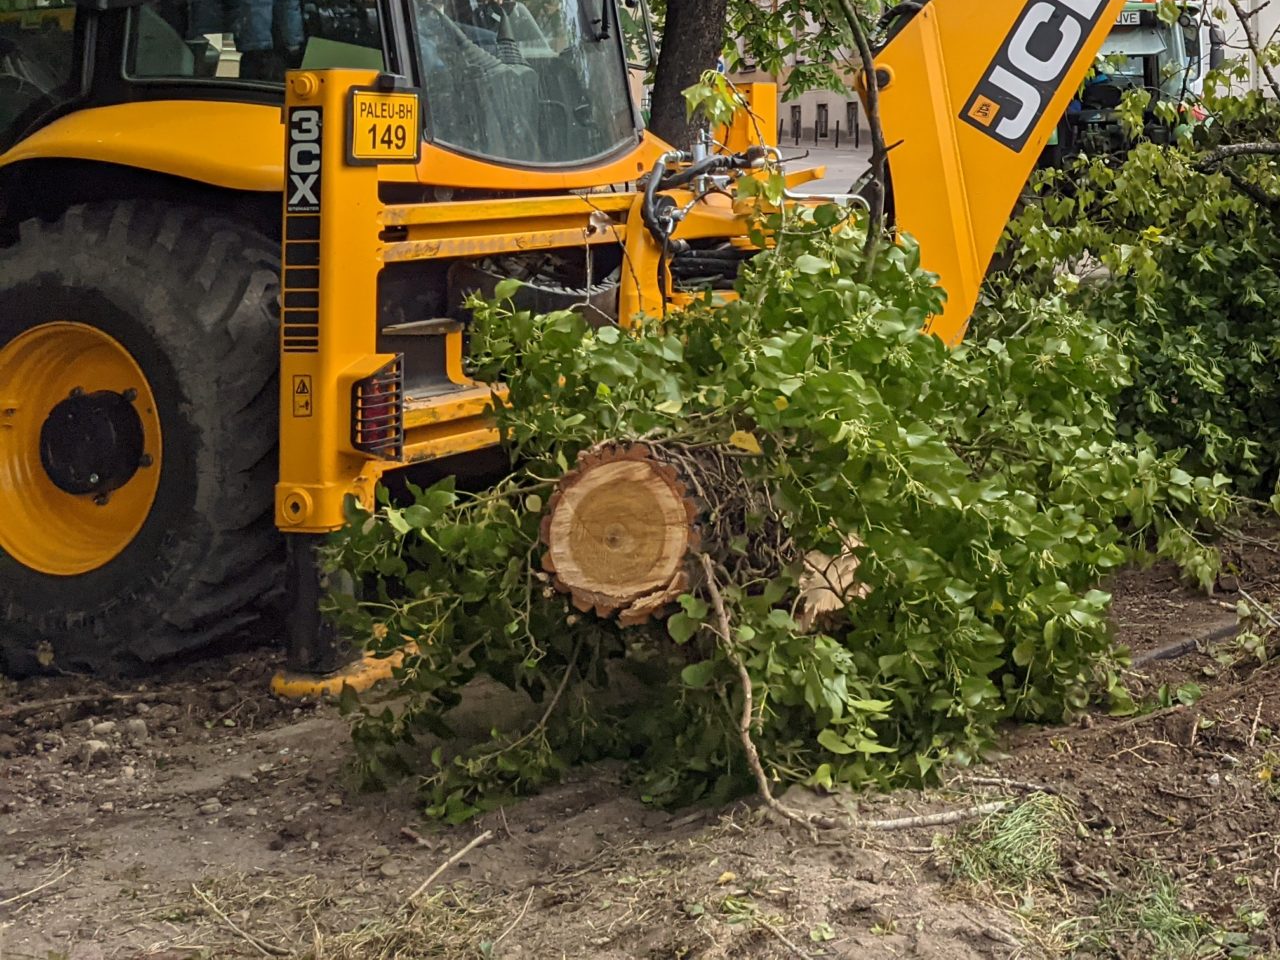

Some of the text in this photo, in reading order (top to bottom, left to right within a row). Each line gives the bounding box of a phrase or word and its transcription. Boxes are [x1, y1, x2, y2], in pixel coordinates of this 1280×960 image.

[360, 102, 413, 119] PALEU-BH
[368, 124, 406, 150] 149
[288, 110, 320, 205] 3CX
